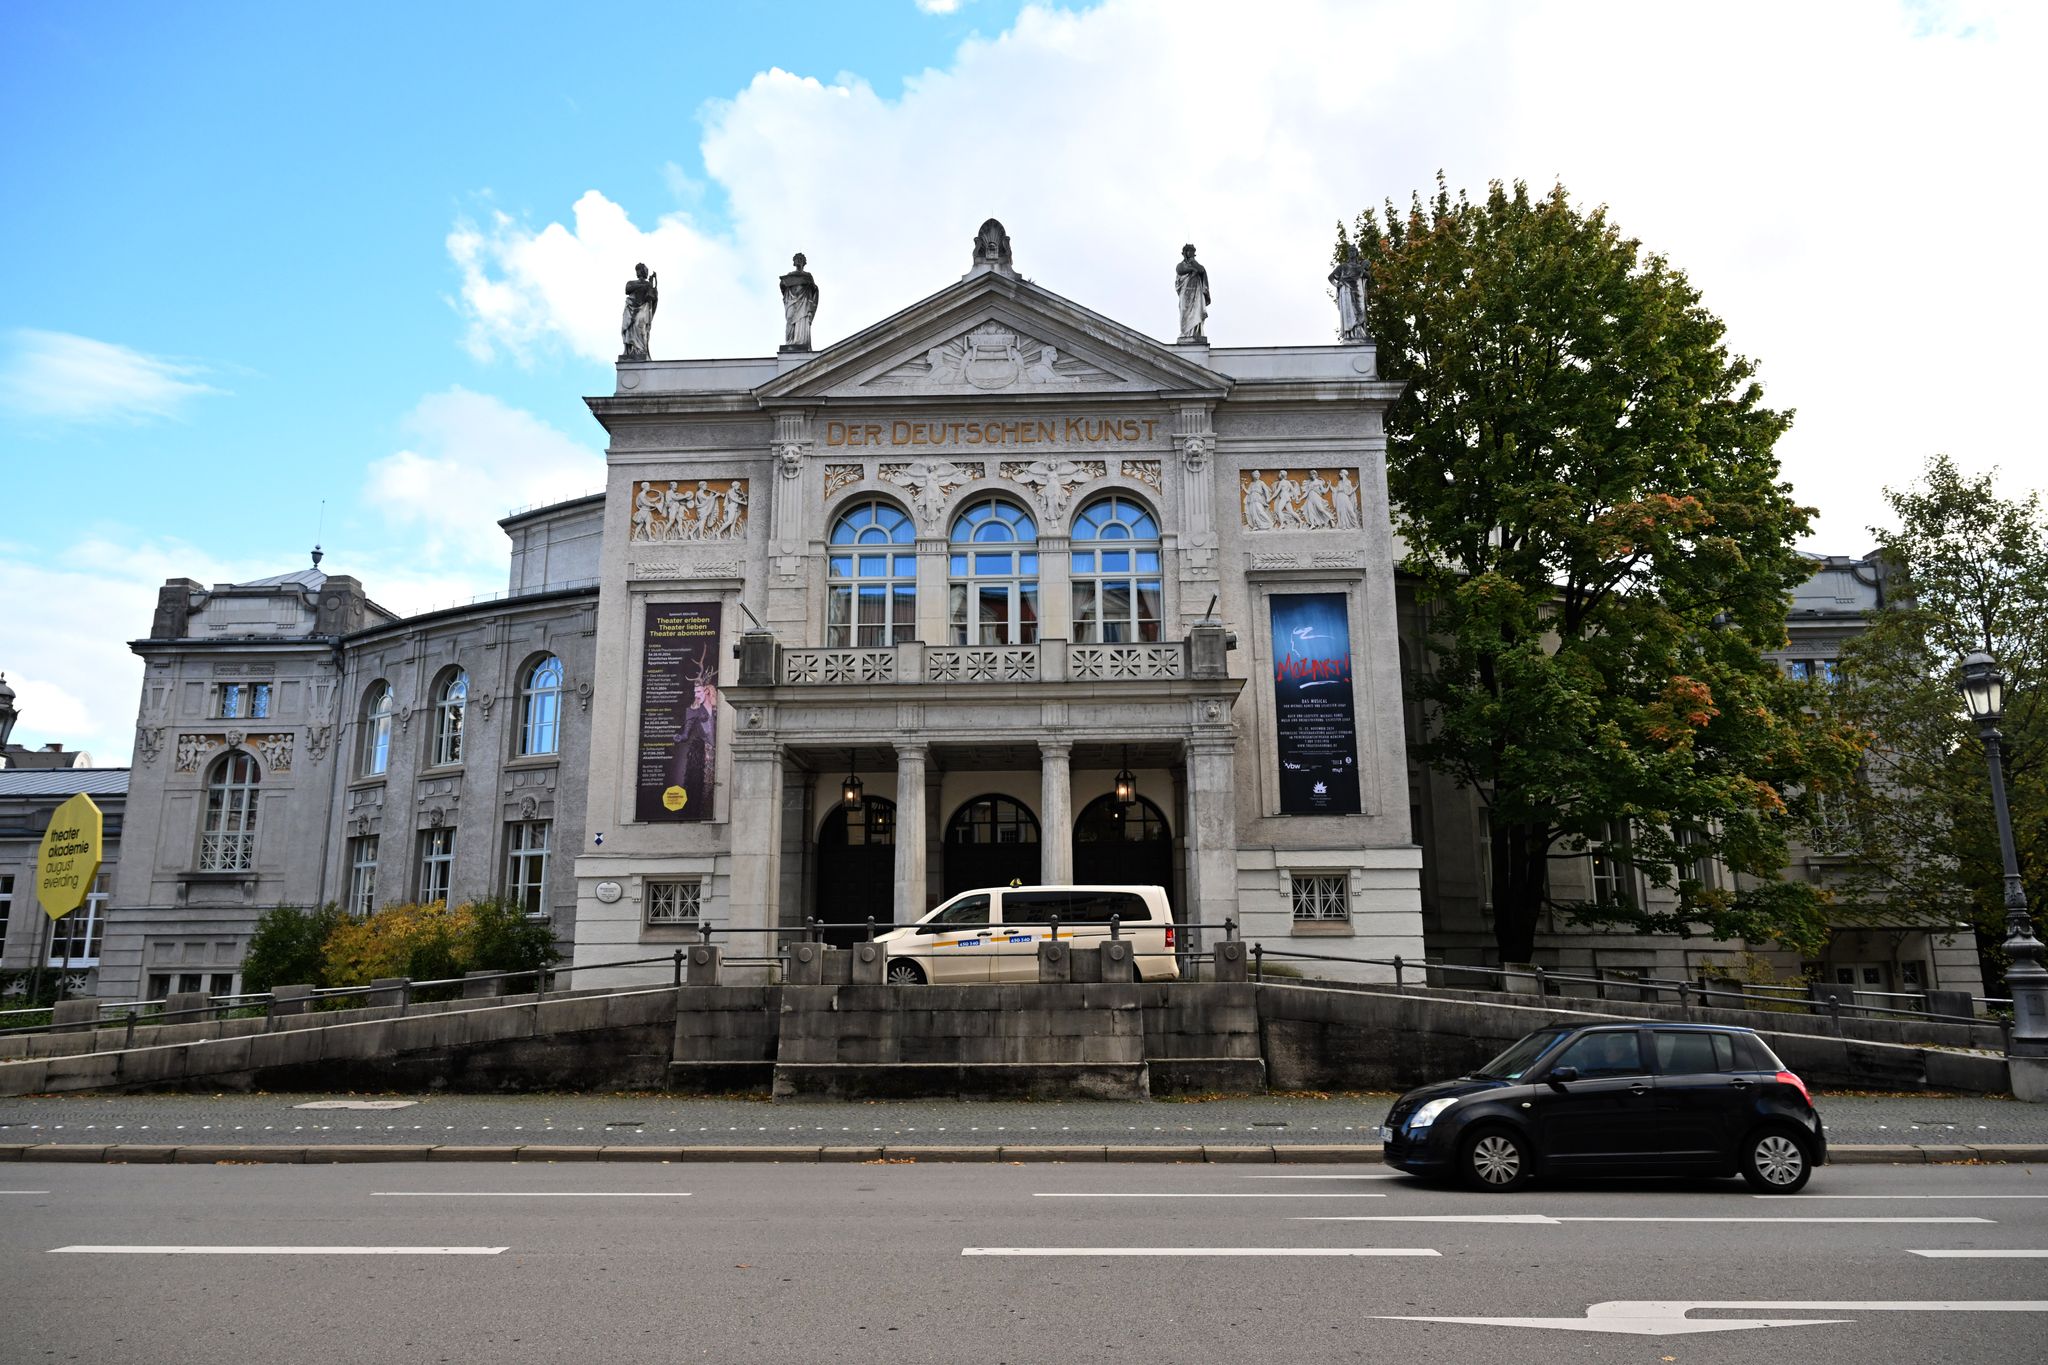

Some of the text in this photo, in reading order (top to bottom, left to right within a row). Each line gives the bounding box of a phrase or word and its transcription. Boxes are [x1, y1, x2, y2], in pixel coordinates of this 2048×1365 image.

[826, 416, 1160, 446] DER DEUTSCHEN KUNST
[1277, 651, 1352, 682] MOZART!
[50, 827, 80, 842] theater
[48, 841, 89, 858] akademie
[46, 858, 74, 875] august
[44, 874, 79, 889] everding
